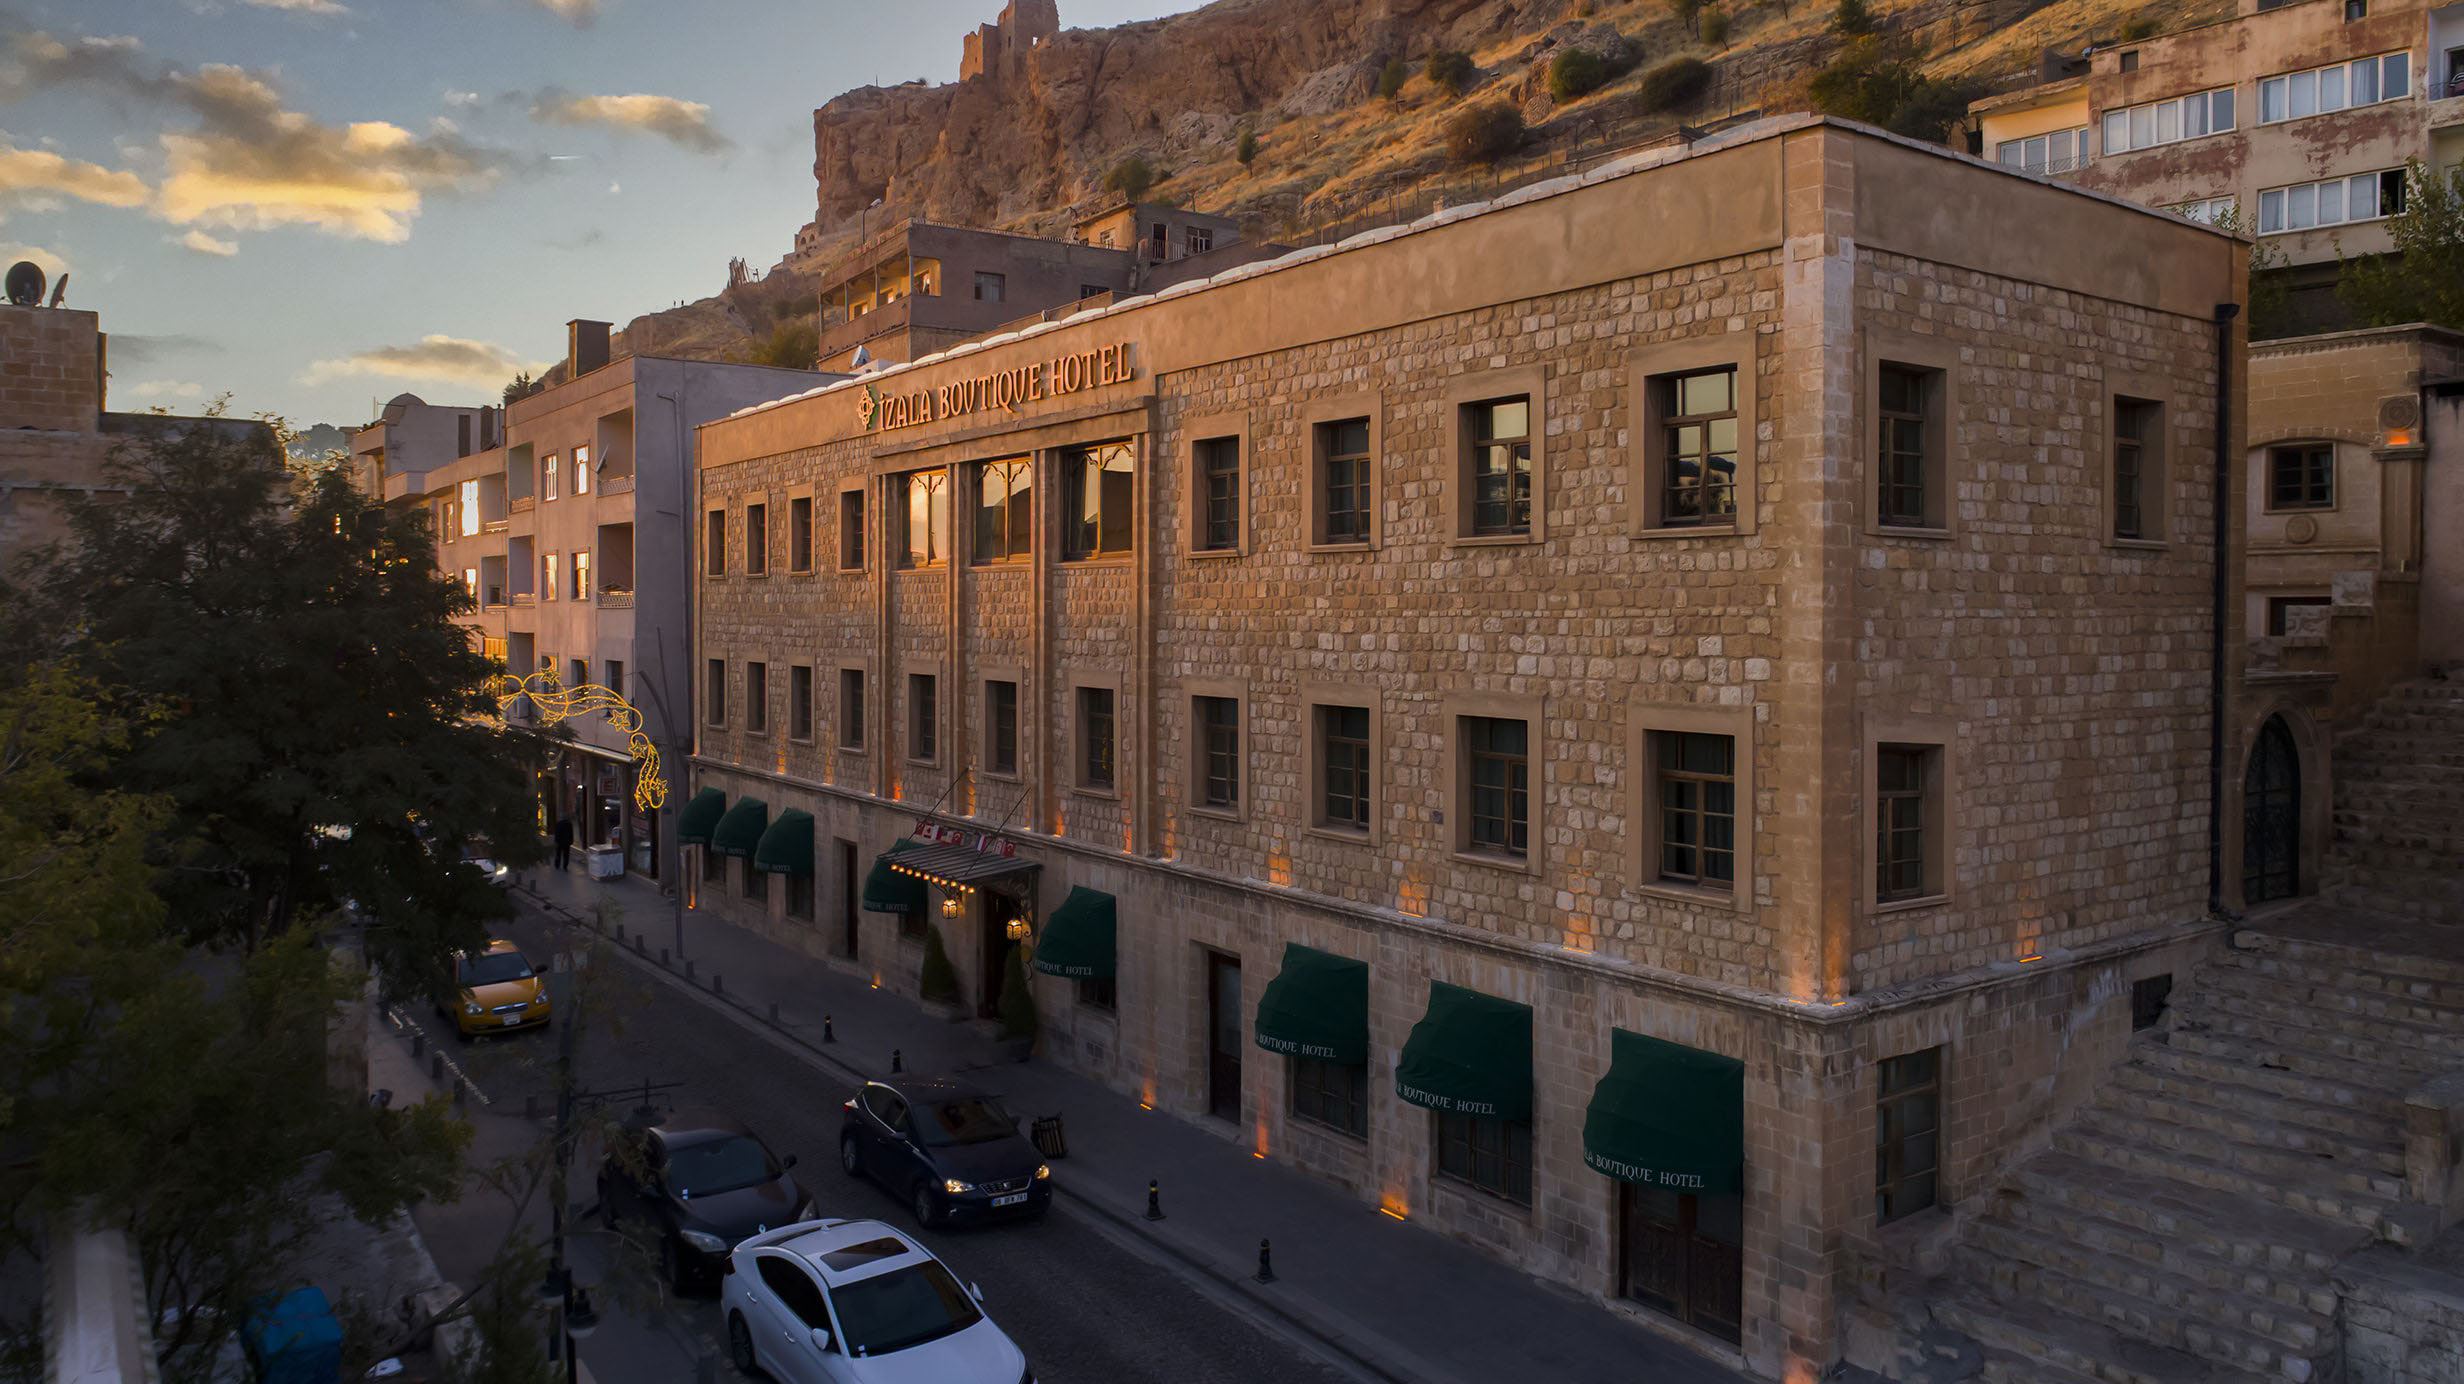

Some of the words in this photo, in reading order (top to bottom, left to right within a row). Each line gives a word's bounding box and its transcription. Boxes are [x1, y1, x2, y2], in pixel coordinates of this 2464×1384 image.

[878, 389, 932, 431] İZALA
[1050, 342, 1134, 397] HOTEL
[1065, 965, 1094, 976] HOTEL
[1301, 1044, 1337, 1058] HOTEL
[1403, 1084, 1452, 1108] BOUTIQUE
[1456, 1099, 1497, 1115] HOTEL
[1596, 1154, 1653, 1182] BOUTIQUE
[1660, 1171, 1705, 1188] HOTEL
